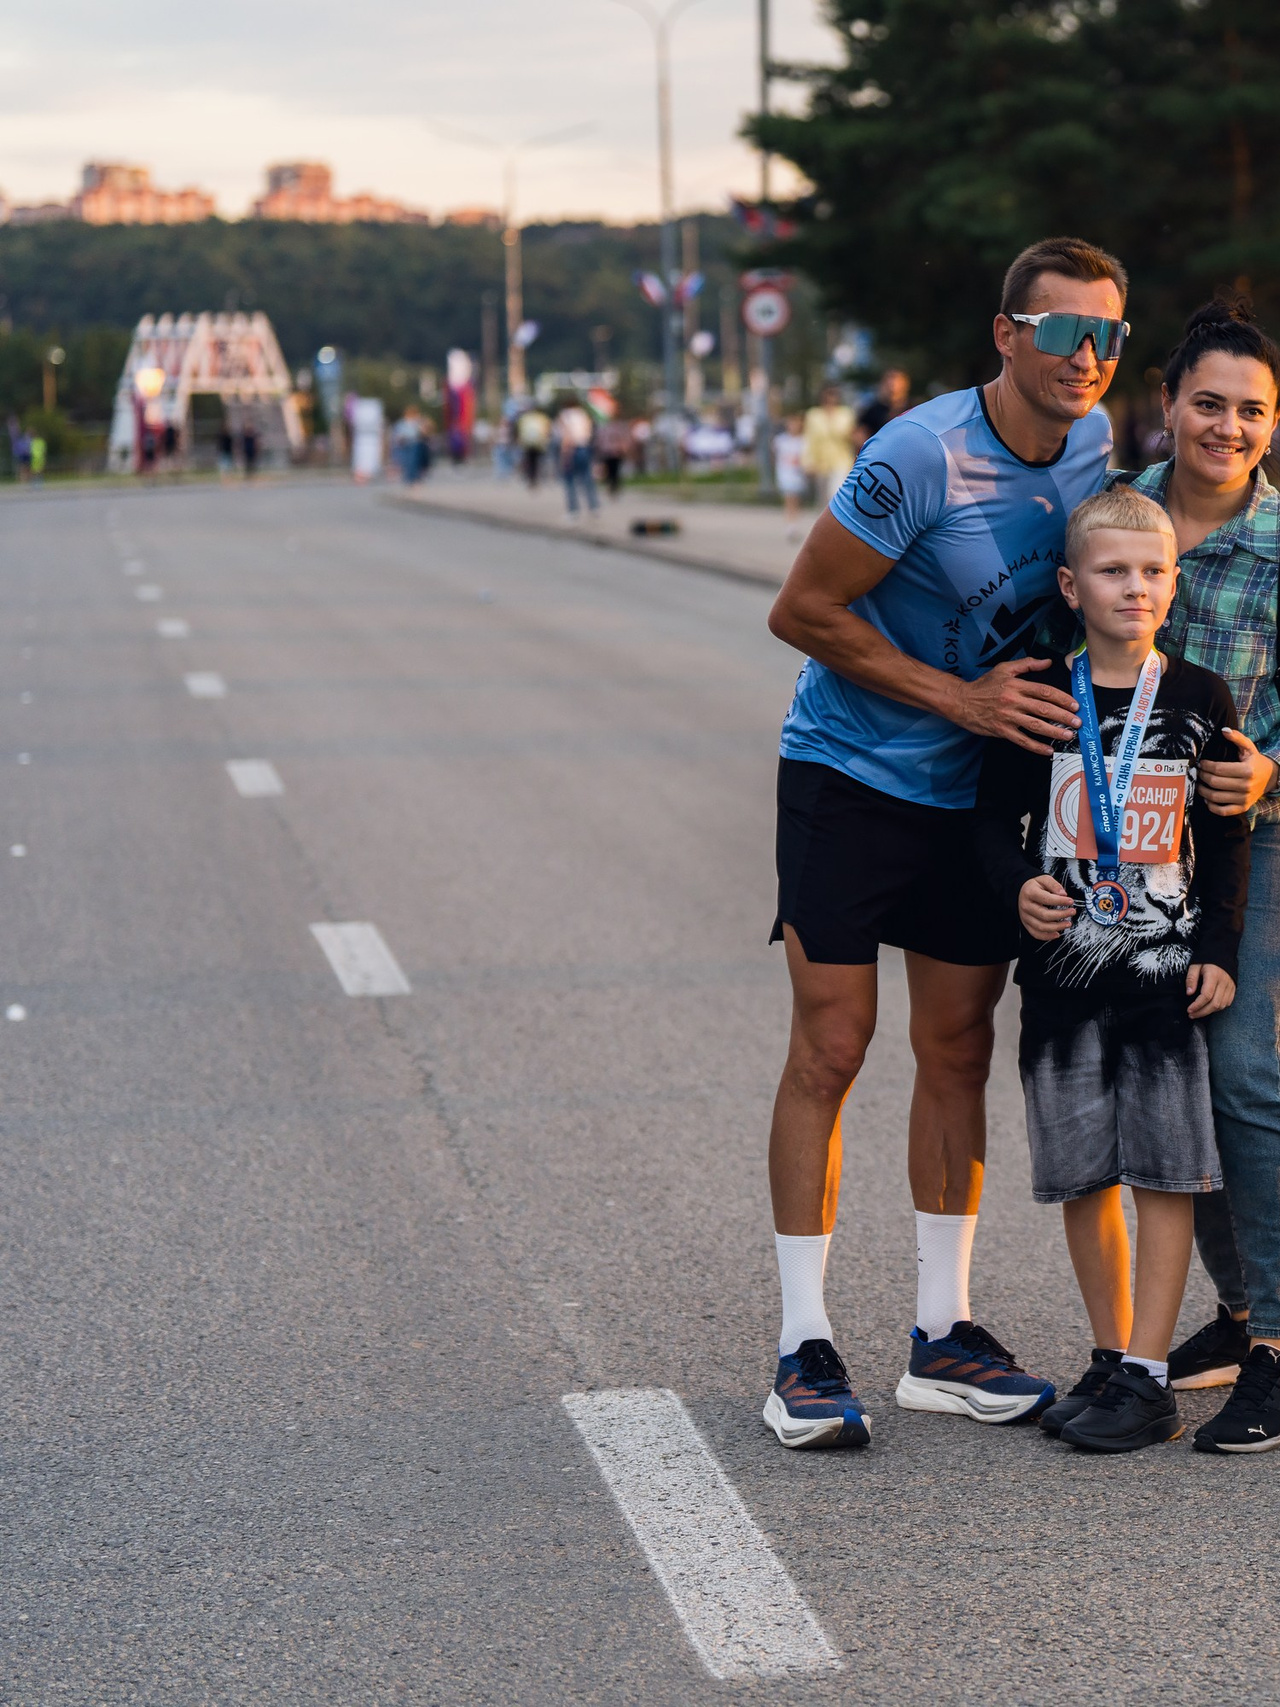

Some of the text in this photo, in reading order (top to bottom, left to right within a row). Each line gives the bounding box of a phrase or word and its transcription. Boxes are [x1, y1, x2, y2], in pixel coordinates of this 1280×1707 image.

[1077, 660, 1087, 694] МАРАФОН
[1138, 677, 1156, 711] АВГУСТА
[1134, 711, 1145, 723] 29
[1087, 740, 1102, 787] КАЛУЖСКИЙ
[1116, 725, 1142, 790] СТАНЬ ПЕРВЫМ
[1099, 793, 1111, 833] СПОРТ 40
[1118, 793, 1124, 803] 40
